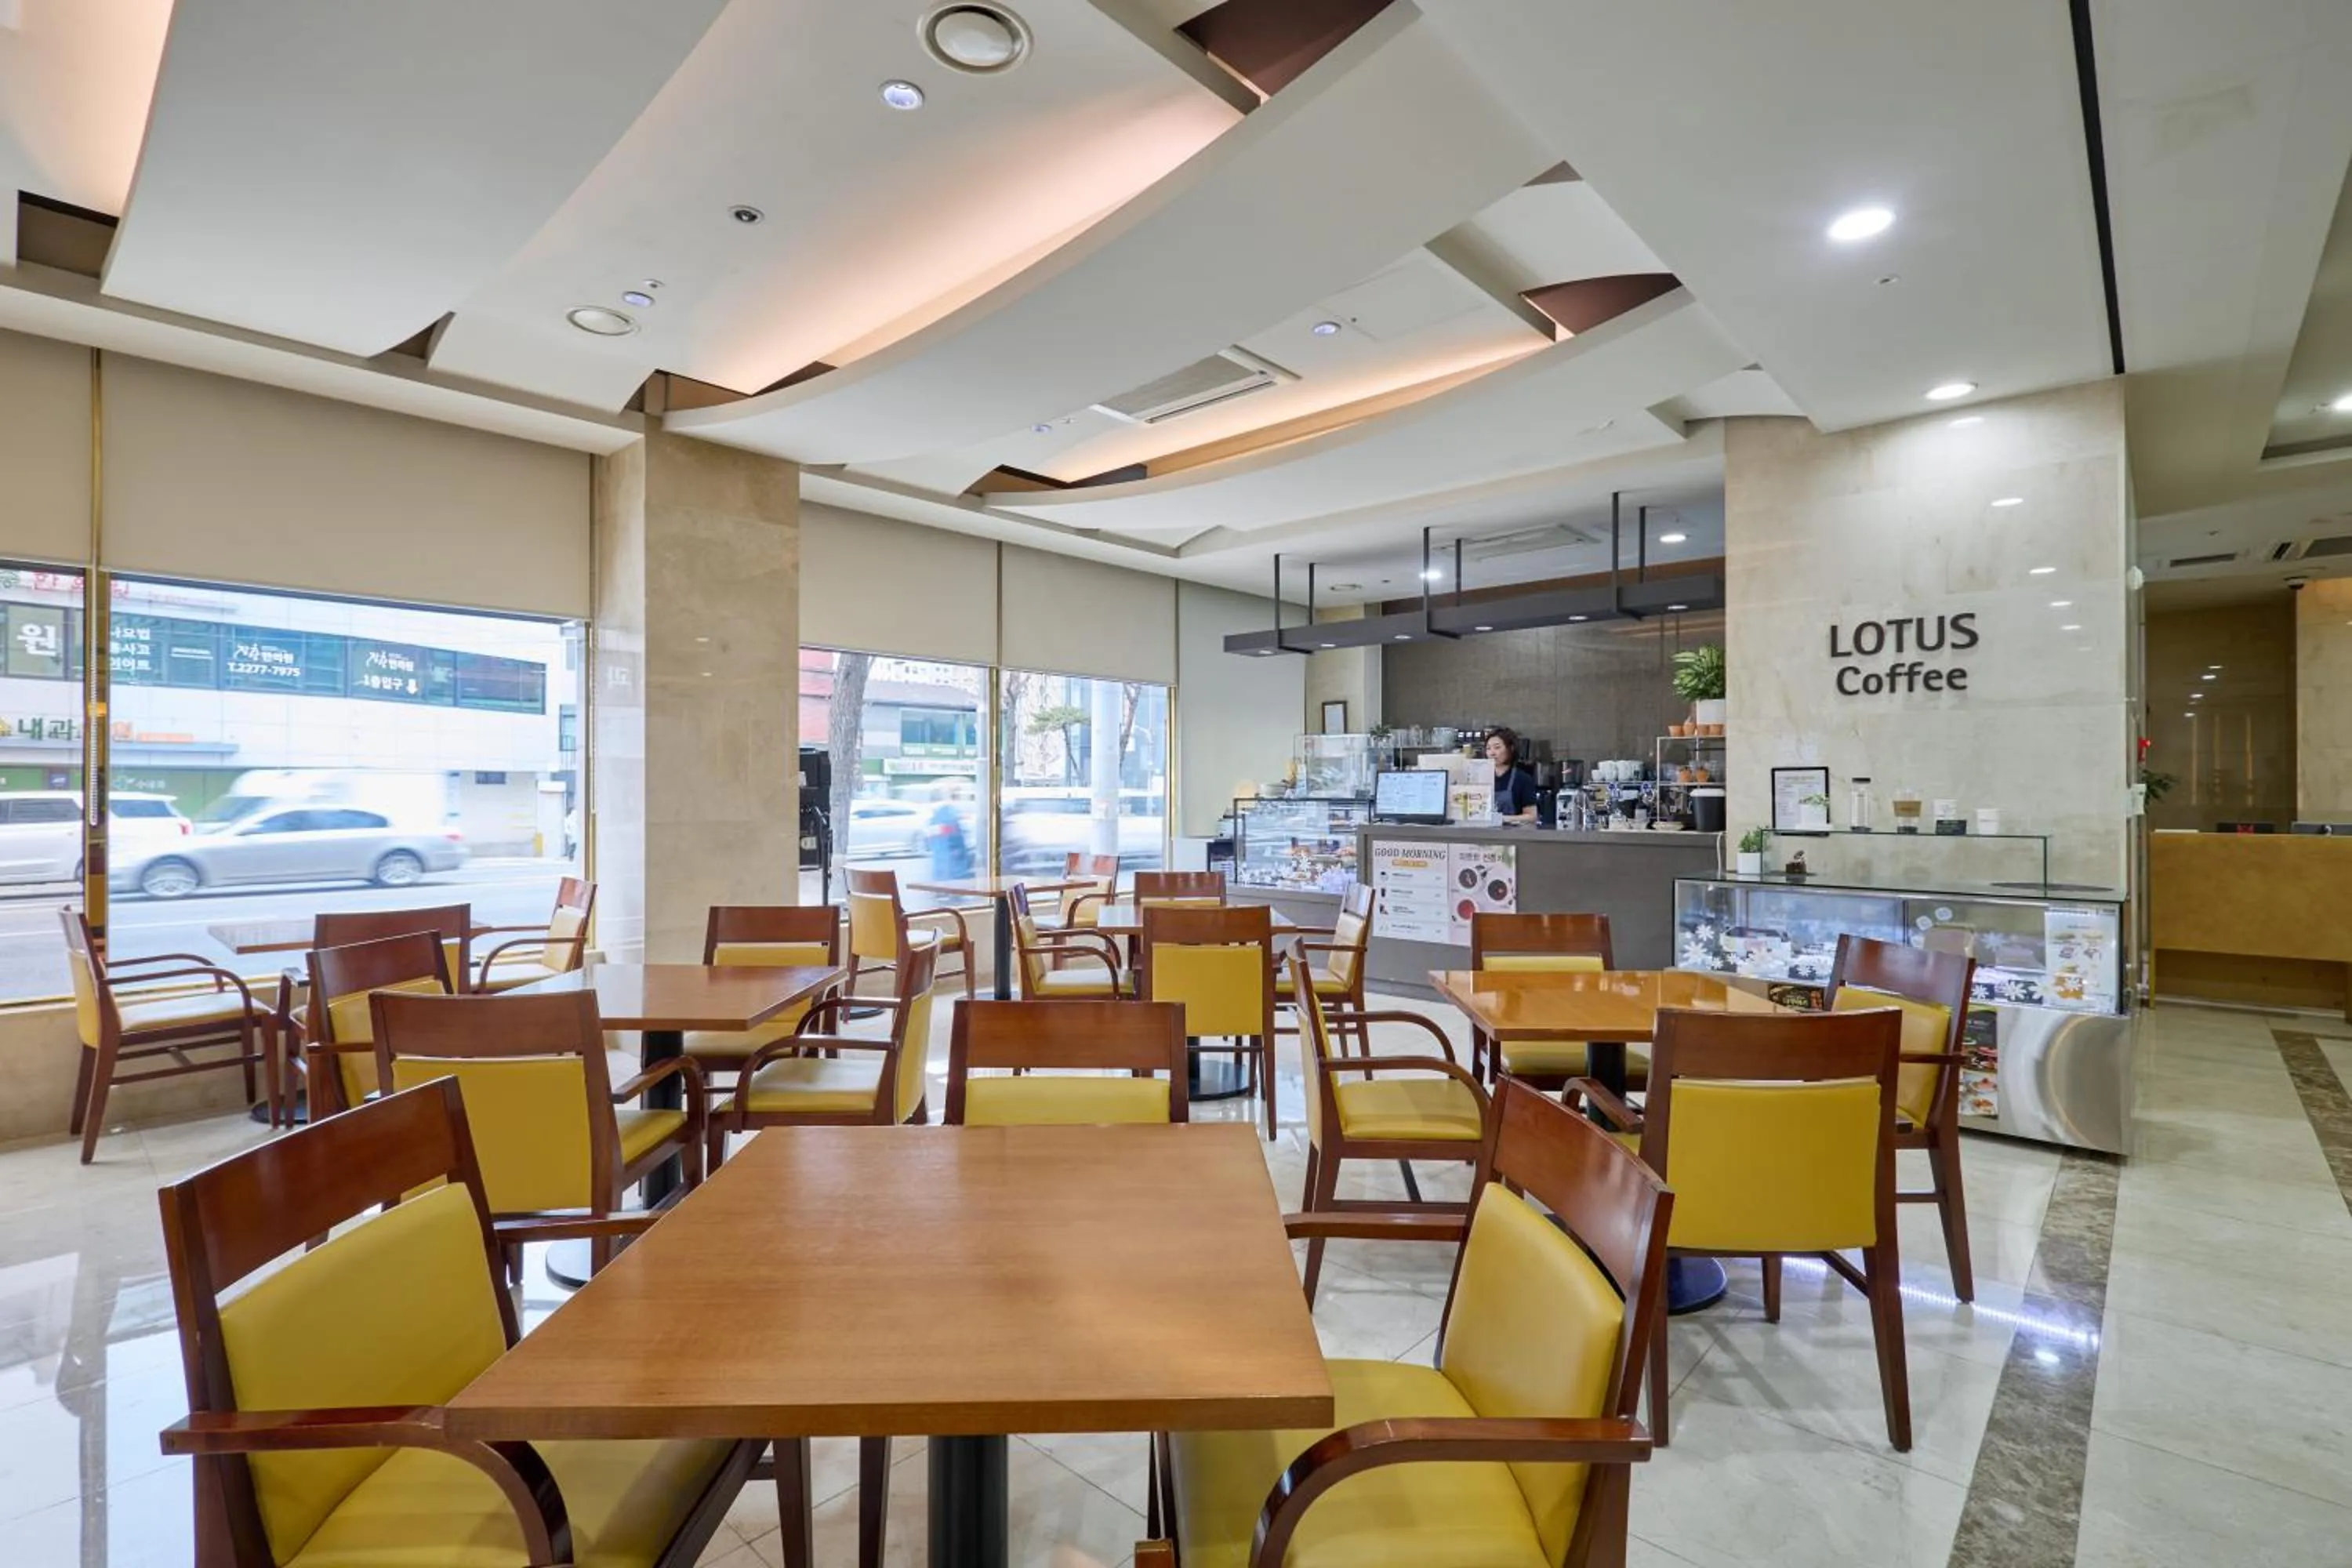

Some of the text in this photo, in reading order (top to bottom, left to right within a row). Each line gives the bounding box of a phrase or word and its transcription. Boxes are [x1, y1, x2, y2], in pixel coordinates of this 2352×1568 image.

[16, 622, 58, 657] 원
[1831, 612, 1979, 658] LOTUS
[1836, 661, 1969, 696] Coffee
[1374, 848, 1446, 860] GOOD MORNING
